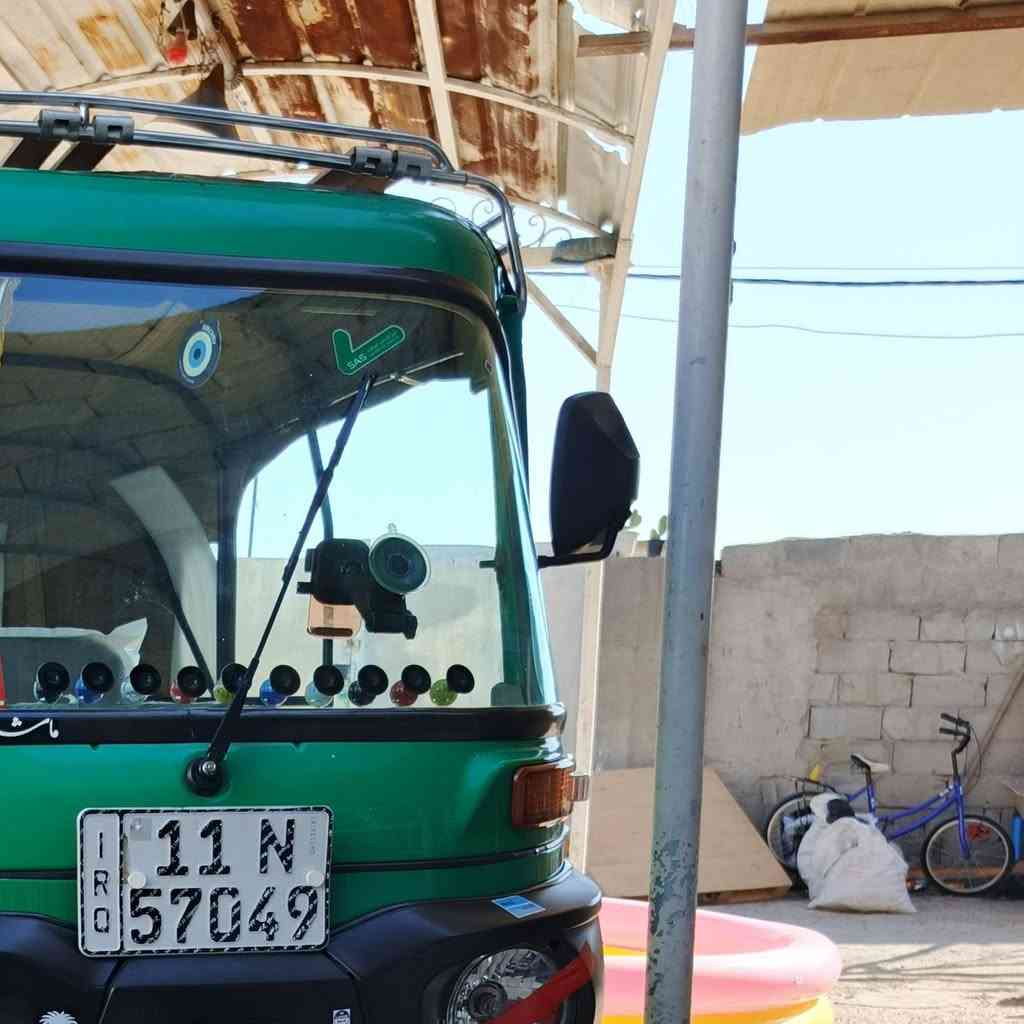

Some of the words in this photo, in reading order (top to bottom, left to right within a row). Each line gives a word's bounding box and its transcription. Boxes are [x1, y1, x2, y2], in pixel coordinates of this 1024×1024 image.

[157, 819, 231, 876] 11
[259, 818, 295, 874] N
[129, 885, 319, 945] 57049
